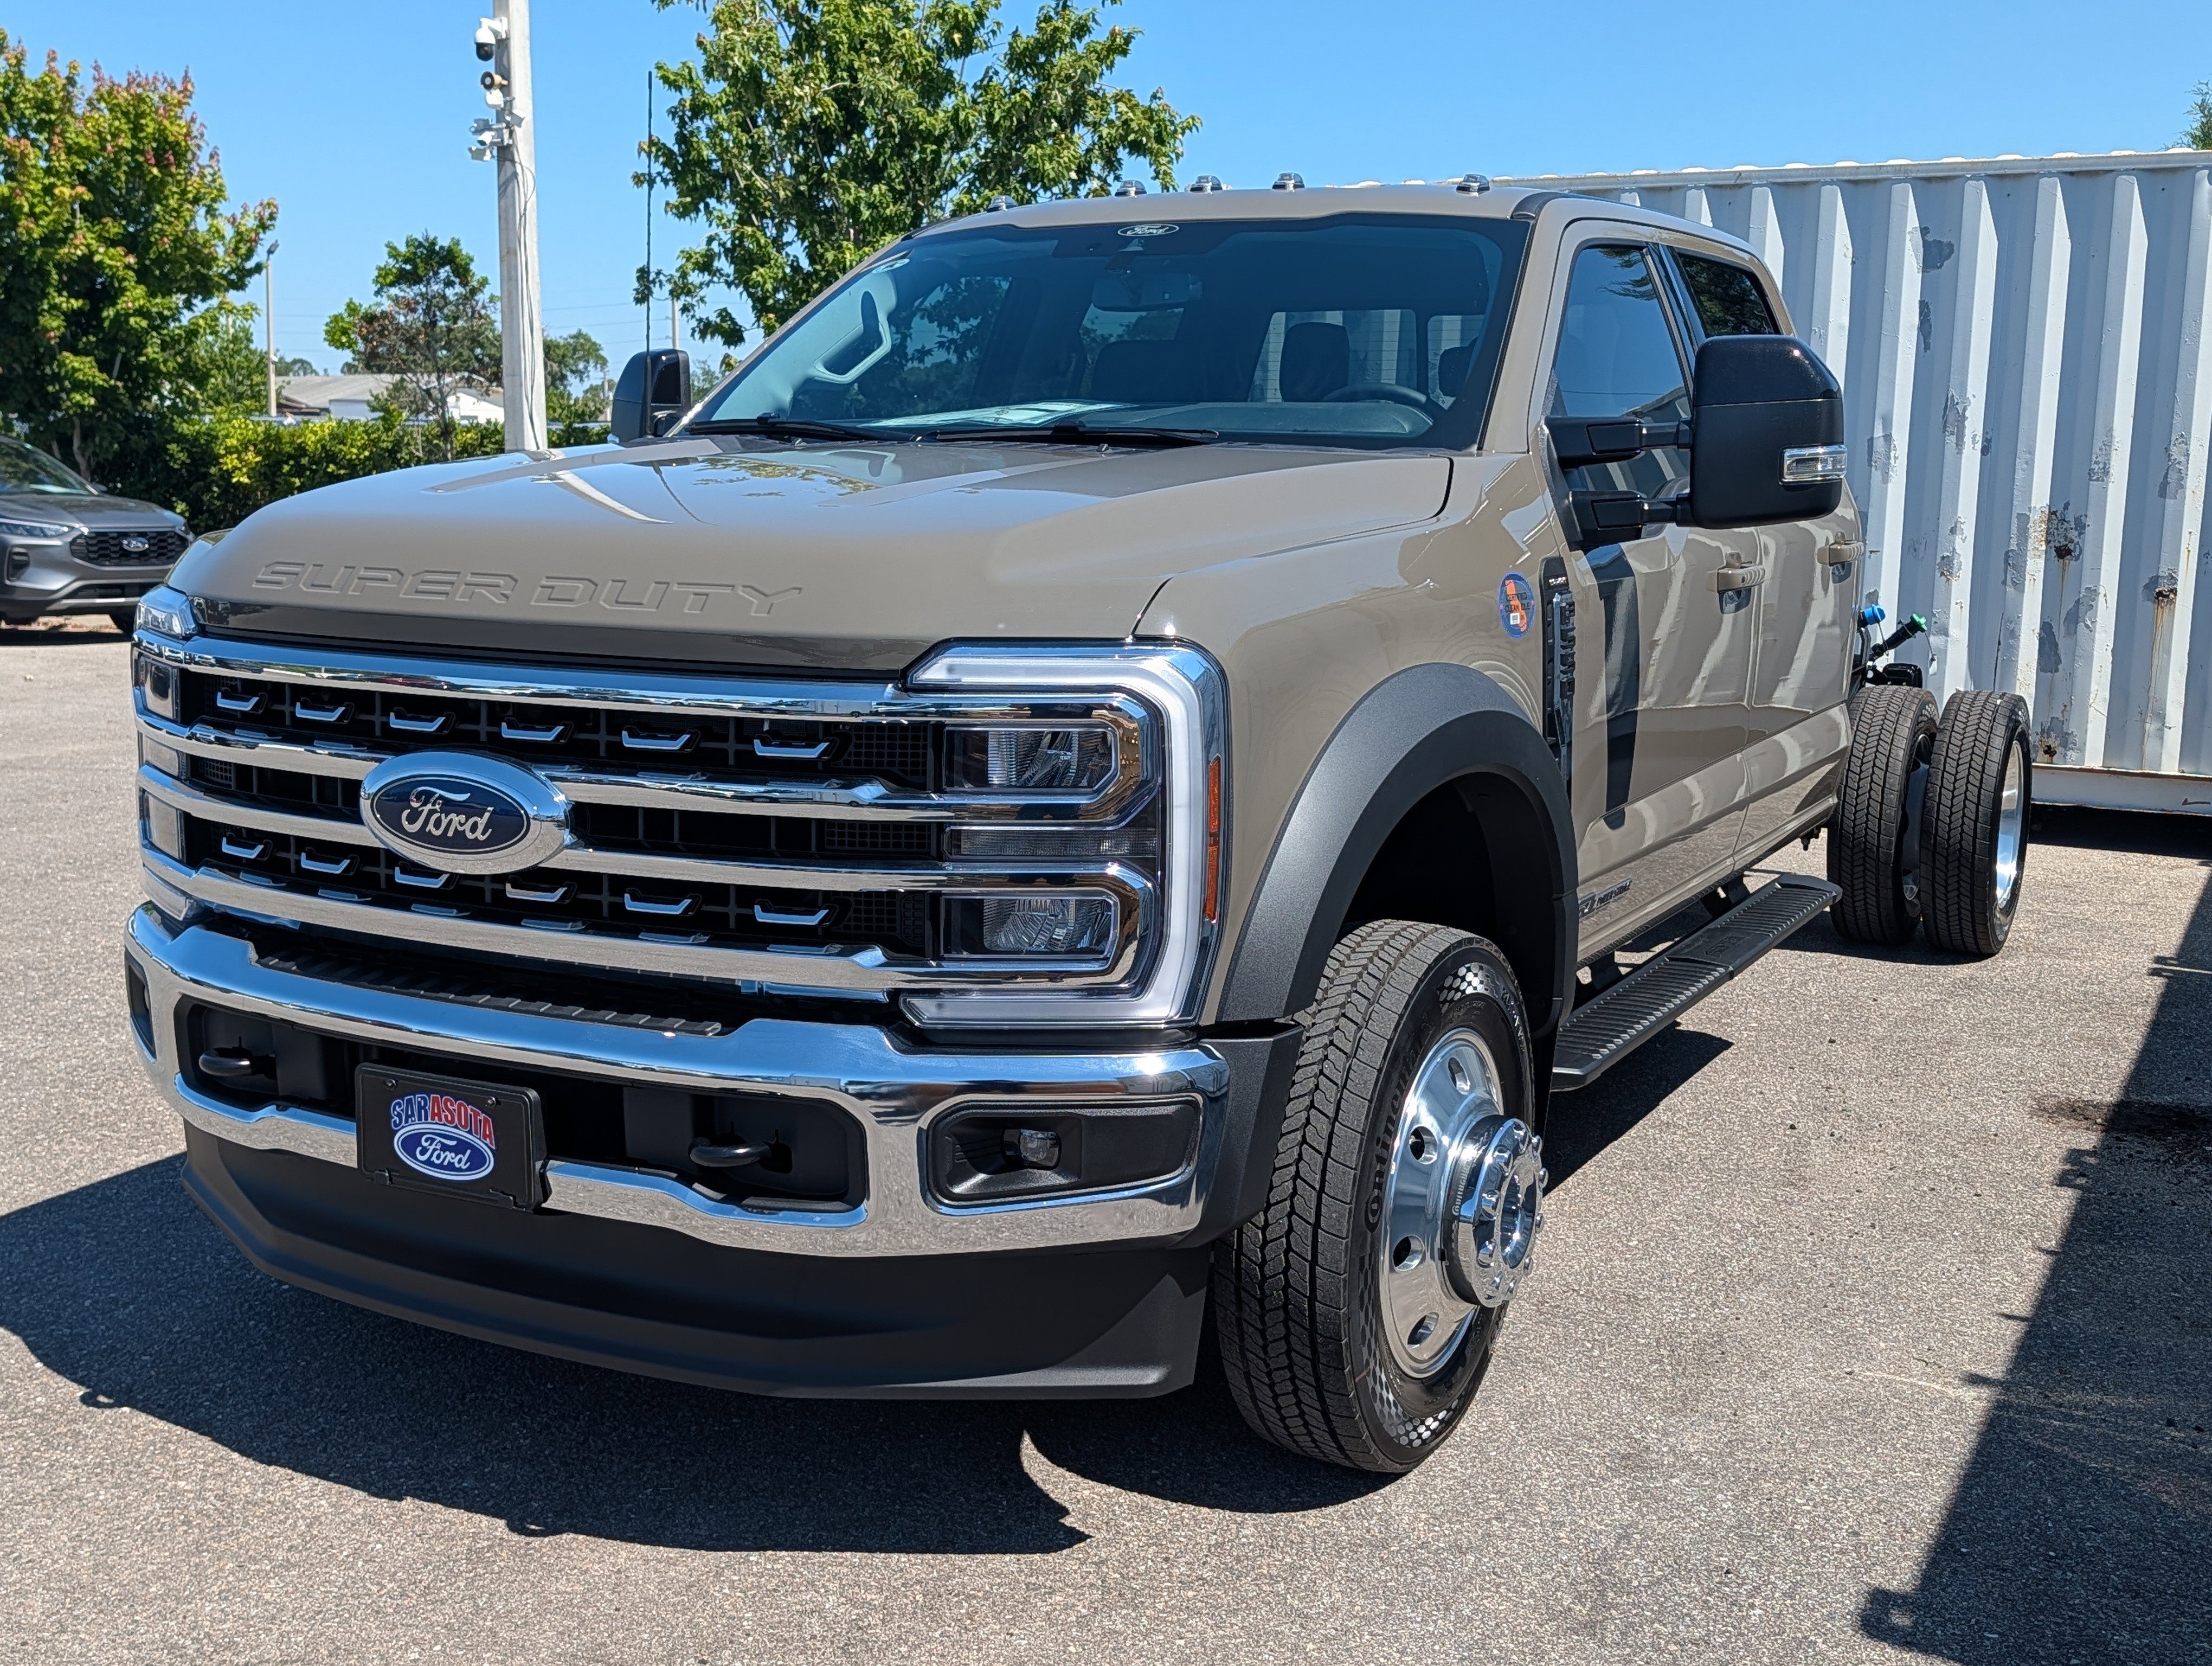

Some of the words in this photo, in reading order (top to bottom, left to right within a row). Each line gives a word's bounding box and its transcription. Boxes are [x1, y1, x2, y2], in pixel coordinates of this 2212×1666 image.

[1126, 223, 1169, 235] Ford
[252, 560, 518, 604] SUPER
[530, 574, 803, 617] DUTY
[401, 786, 494, 841] Ford
[390, 1093, 497, 1151] SARASOTA
[415, 1133, 471, 1170] Ford
